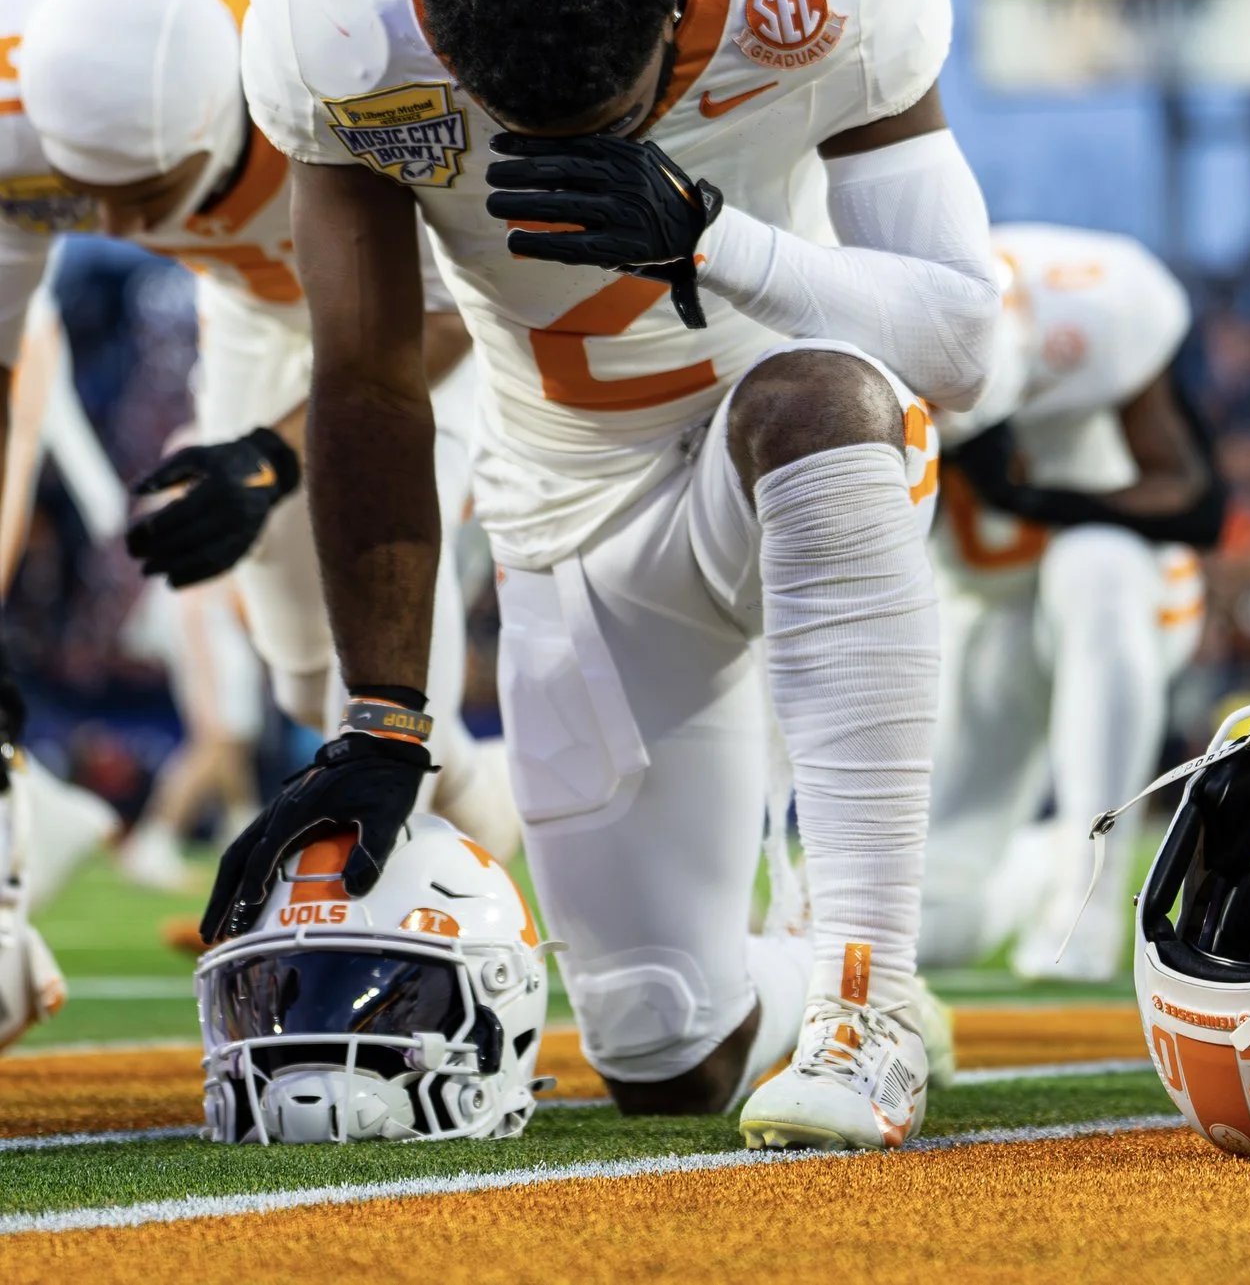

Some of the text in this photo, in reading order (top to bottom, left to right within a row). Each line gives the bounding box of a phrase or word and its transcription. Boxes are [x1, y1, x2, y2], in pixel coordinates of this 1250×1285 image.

[751, 34, 835, 67] GRADUATE
[398, 100, 433, 115] Mutual
[338, 118, 458, 151] MUSIC CITY
[374, 145, 441, 163] BOWL
[280, 905, 348, 927] VOLS
[1164, 1002, 1238, 1030] TENNESSEE
